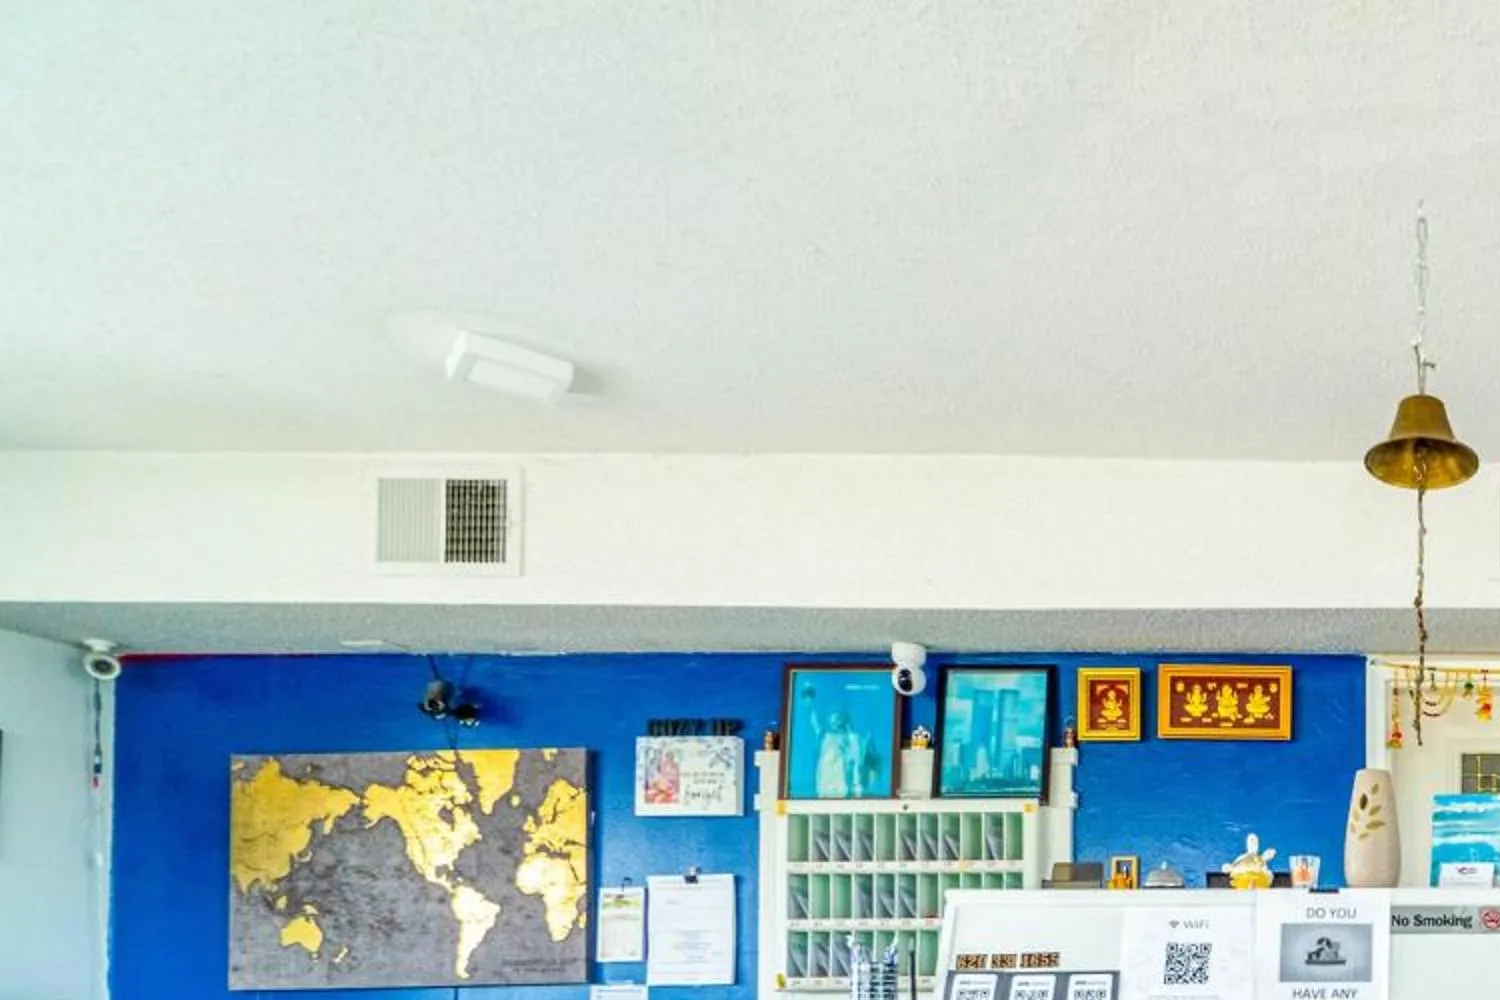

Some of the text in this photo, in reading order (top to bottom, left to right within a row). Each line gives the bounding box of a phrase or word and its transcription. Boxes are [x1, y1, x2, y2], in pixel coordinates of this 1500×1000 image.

[1306, 908, 1357, 919] DO YOU
[1392, 914, 1473, 929] No Smoking
[1293, 988, 1357, 999] HAVE ANY
